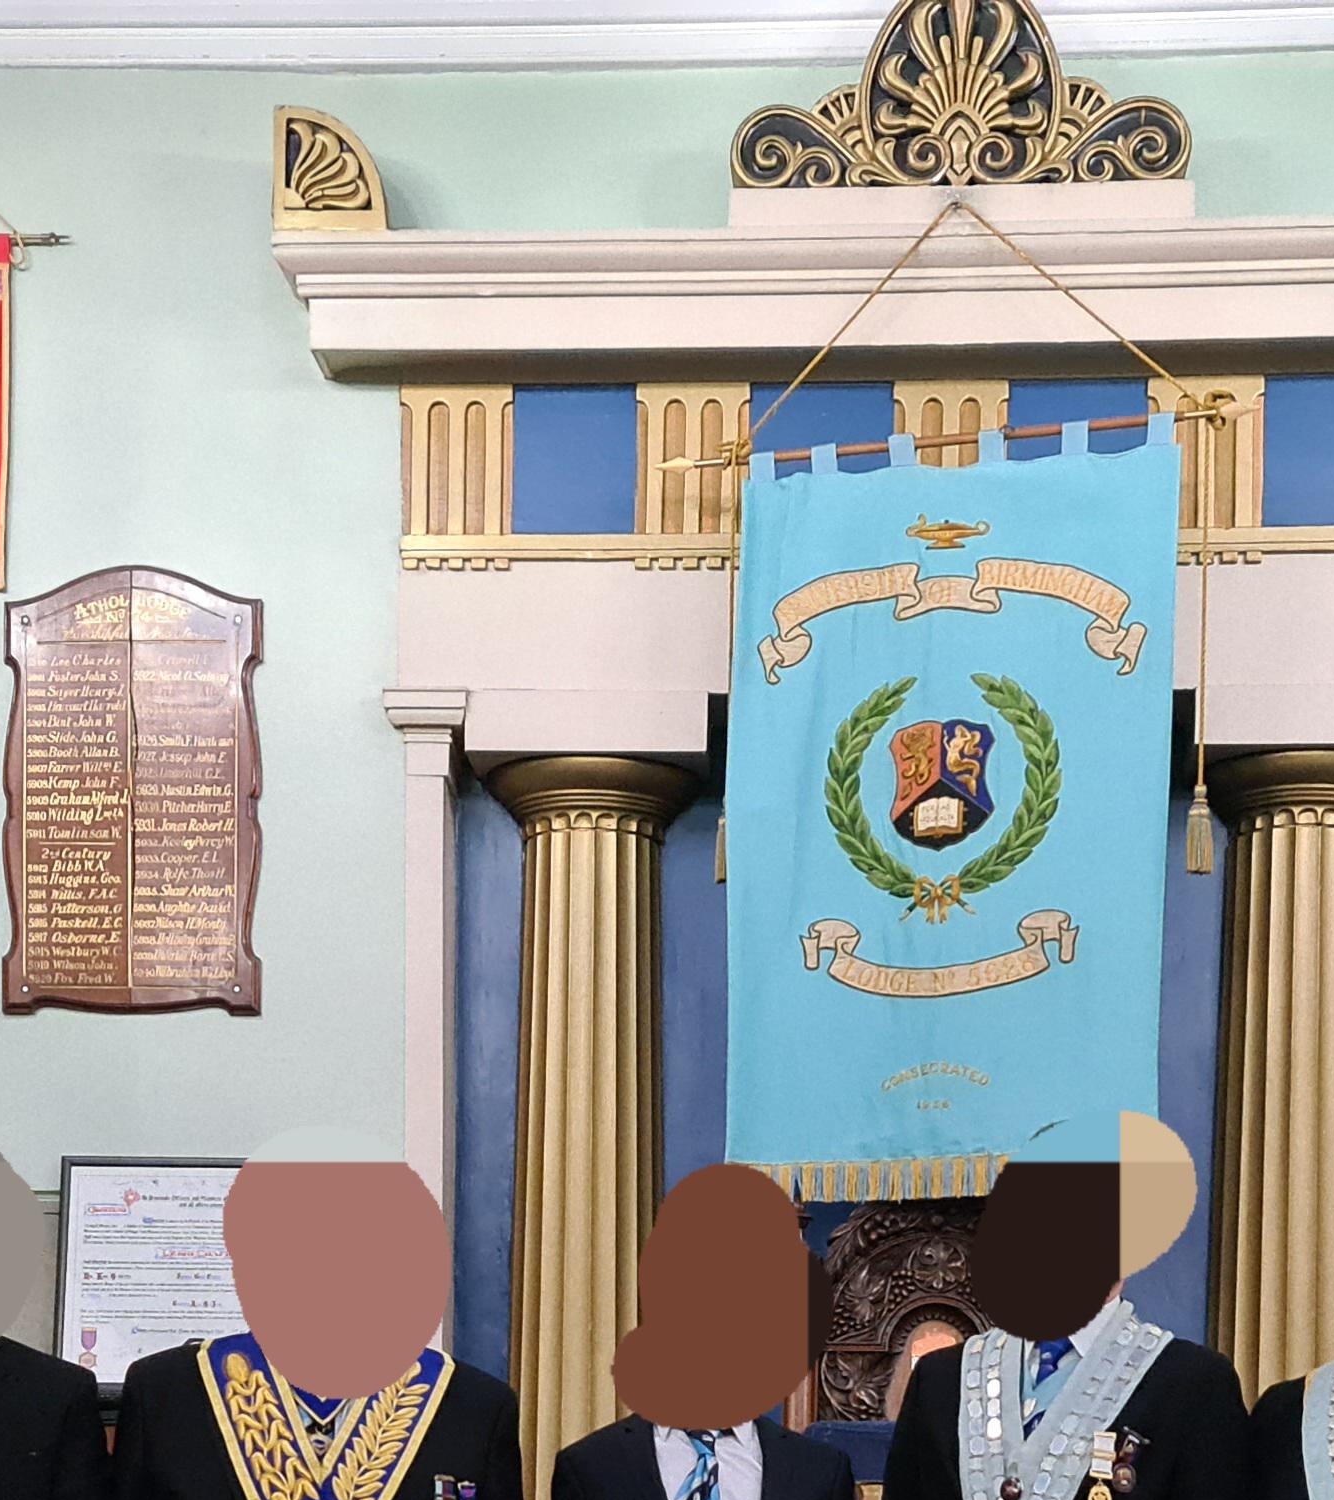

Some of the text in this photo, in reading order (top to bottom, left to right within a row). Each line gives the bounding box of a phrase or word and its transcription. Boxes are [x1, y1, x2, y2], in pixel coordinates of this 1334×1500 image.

[74, 594, 130, 620] ATHOL
[927, 581, 955, 605] OF
[981, 566, 1121, 619] BIRMINGHAM
[61, 848, 112, 860] Century
[840, 960, 916, 993] LODGE
[881, 1060, 989, 1092] CONSECRATED
